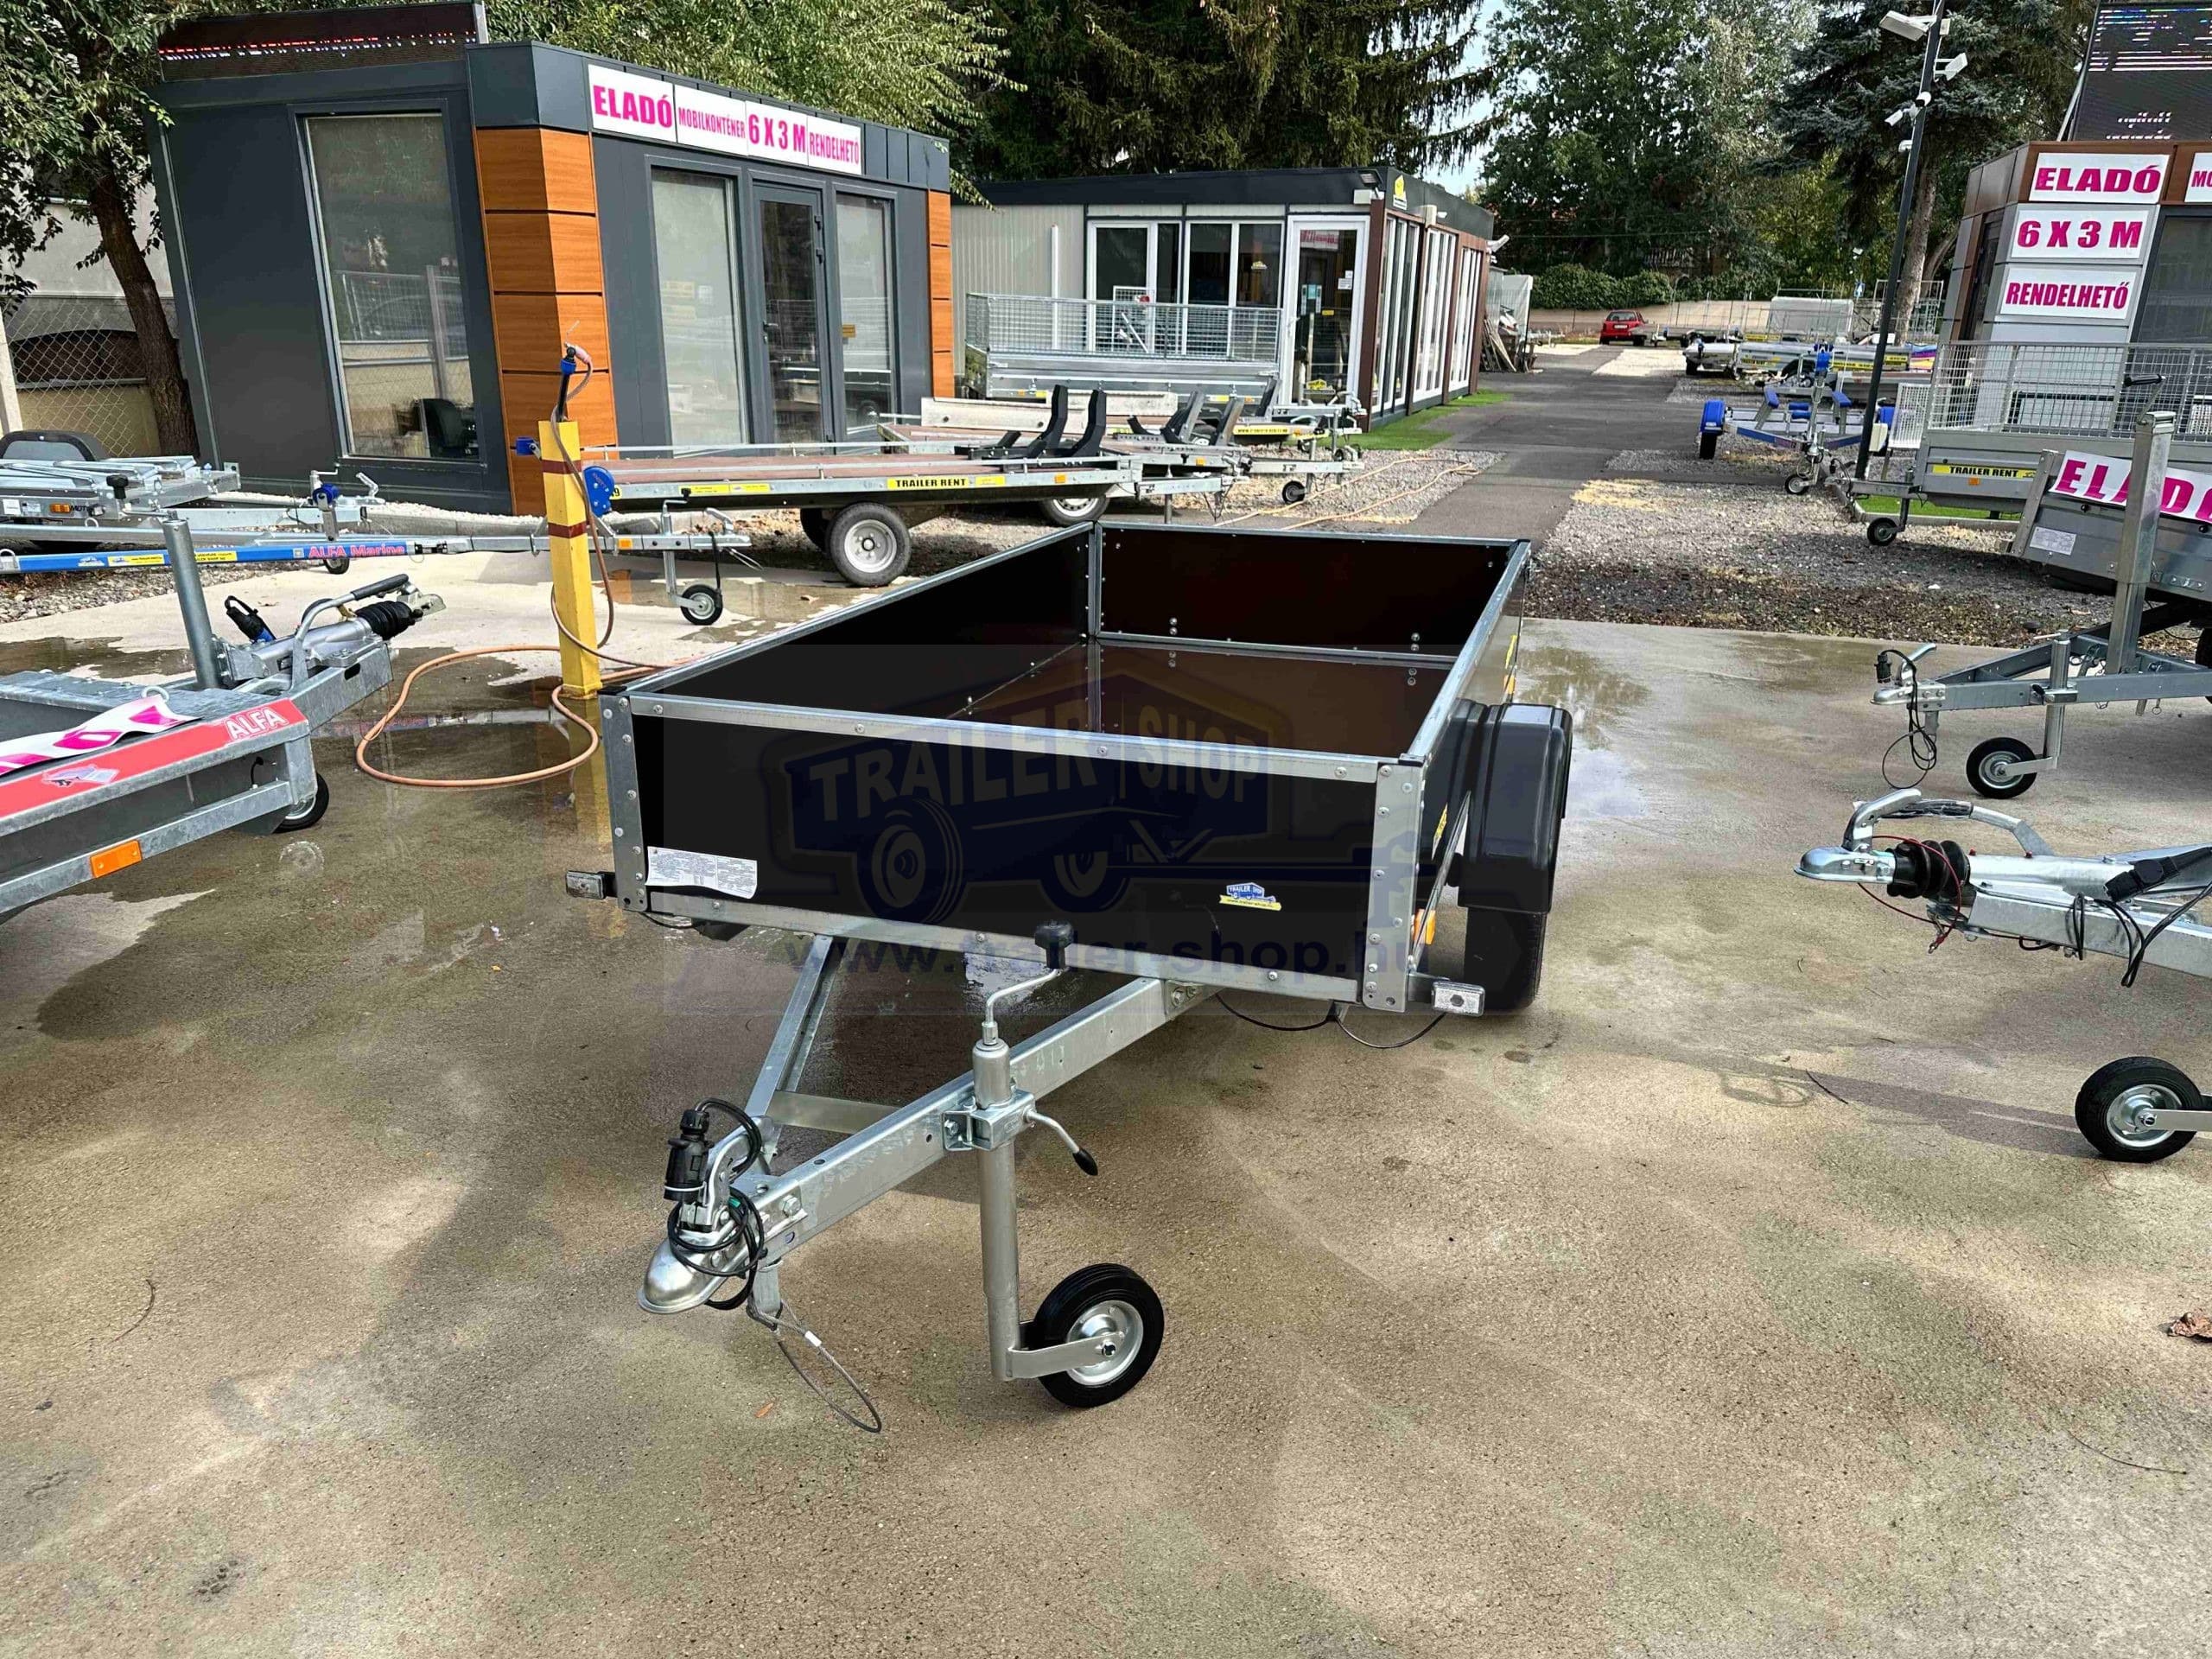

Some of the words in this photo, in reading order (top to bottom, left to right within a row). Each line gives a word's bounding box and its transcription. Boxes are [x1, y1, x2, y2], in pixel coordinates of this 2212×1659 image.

[593, 85, 672, 129] ELADÓ
[678, 107, 746, 139] MOBILKONTÉNER
[748, 113, 760, 144] 6
[764, 116, 775, 147] X
[779, 119, 789, 149] 3
[793, 123, 806, 153] M
[2034, 164, 2161, 194] ELADÓ
[2017, 220, 2041, 248] 6
[2046, 221, 2071, 248] X
[2077, 220, 2101, 249] 3
[2108, 221, 2143, 249] M
[2005, 282, 2130, 309] RENDELHETŐ
[895, 478, 938, 488] TRAILER
[940, 478, 966, 487] RENT
[1949, 465, 1990, 476] TRAILER
[1992, 467, 2018, 478] RENT
[2055, 458, 2212, 523] ELD
[308, 545, 346, 559] ALFA
[349, 543, 406, 556] Marine
[226, 708, 287, 741] ALFA
